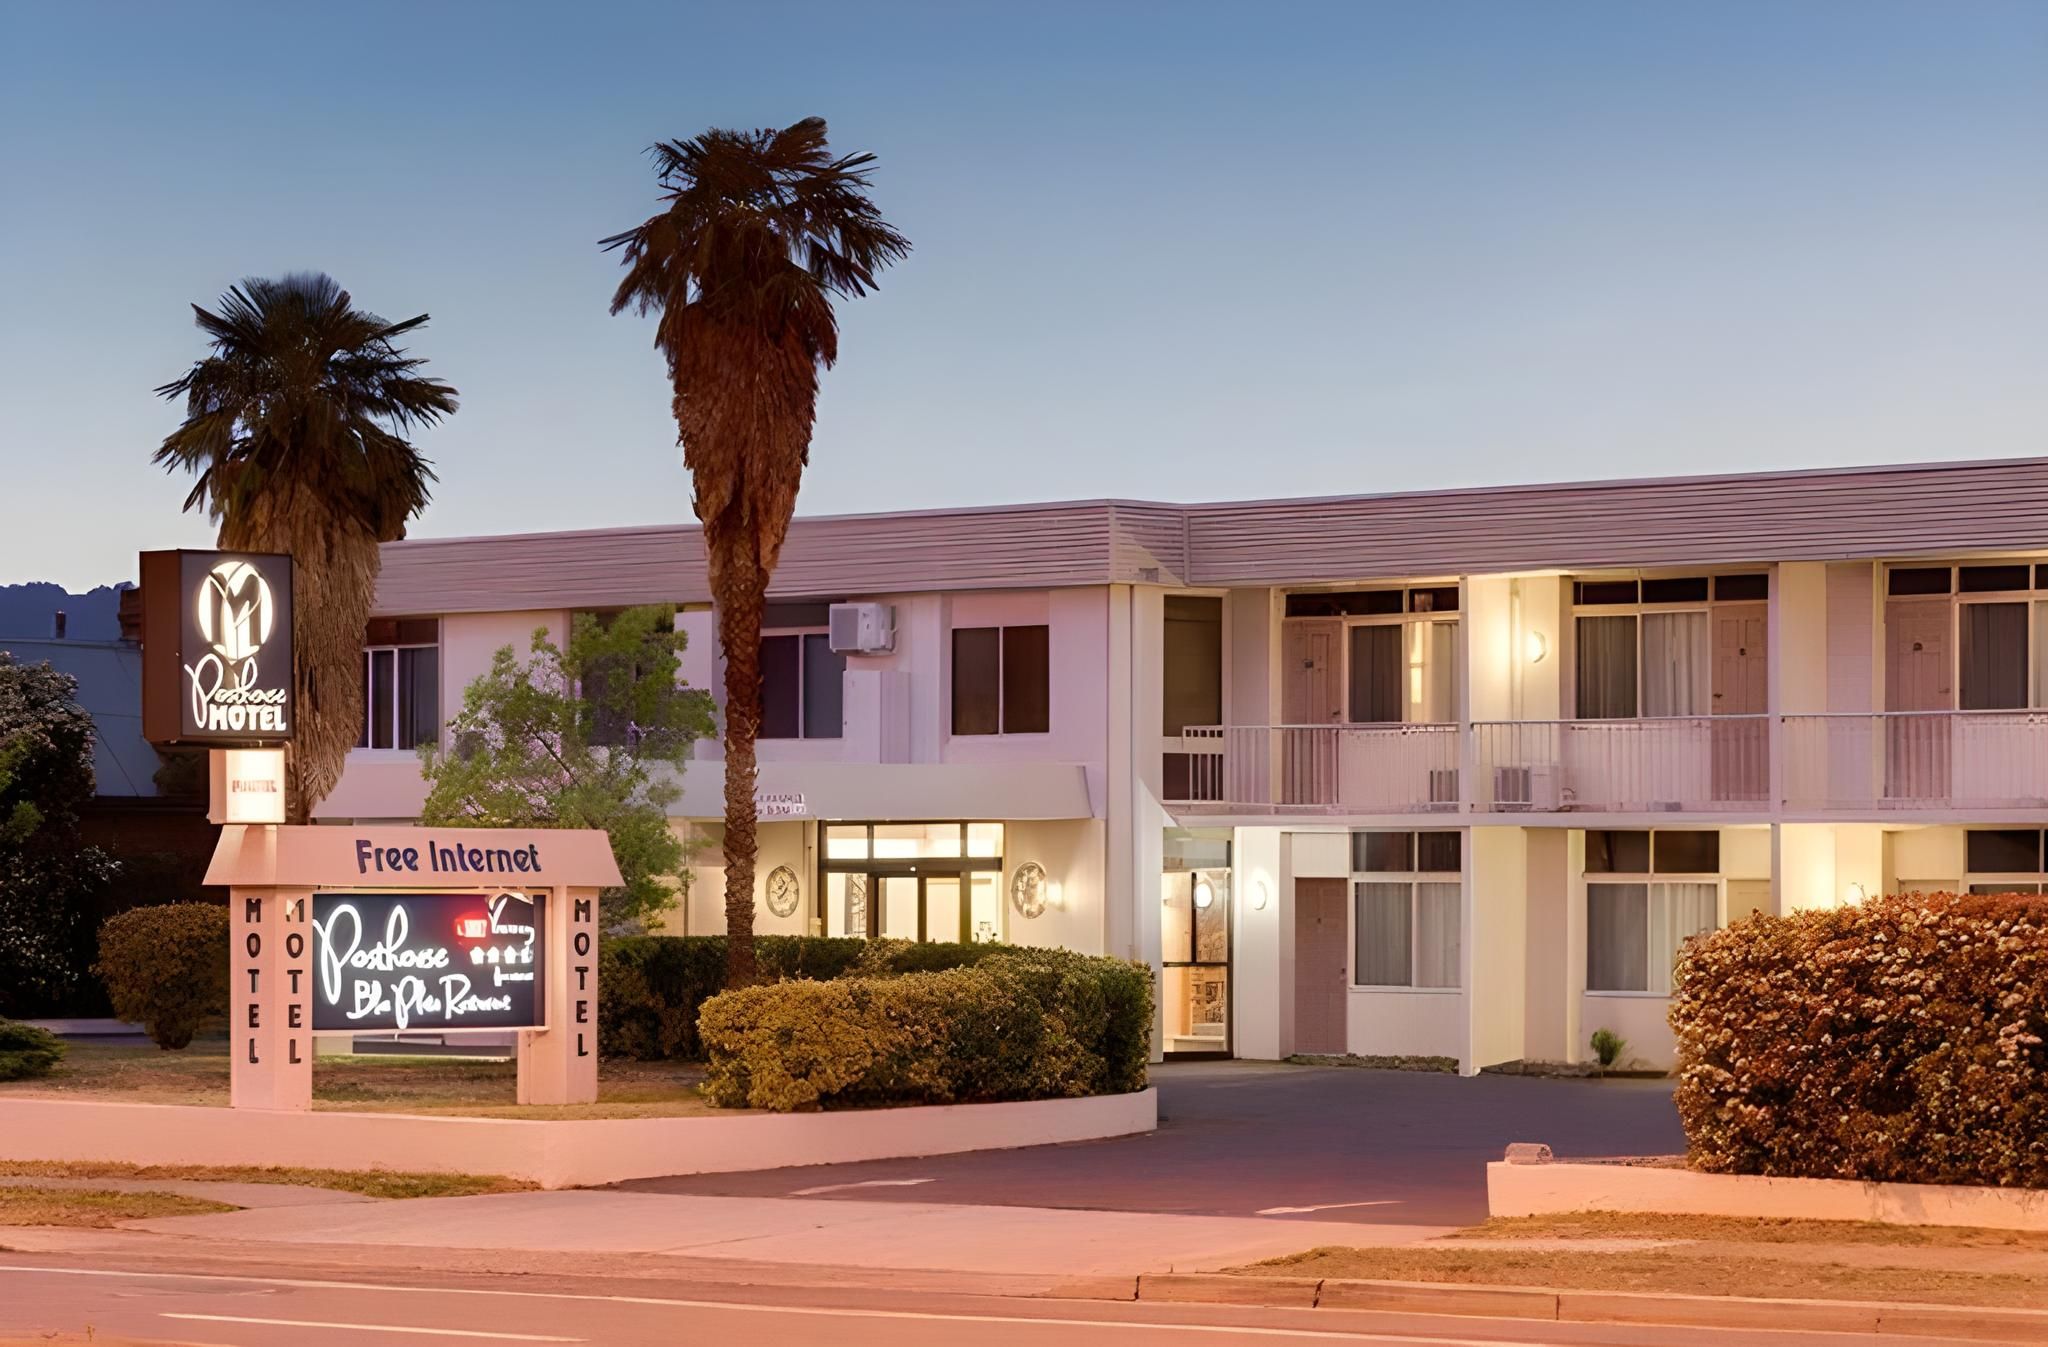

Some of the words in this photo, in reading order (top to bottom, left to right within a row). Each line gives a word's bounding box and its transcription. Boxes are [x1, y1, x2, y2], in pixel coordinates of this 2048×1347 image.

[355, 839, 419, 874] Free
[428, 840, 542, 873] Internet
[245, 898, 262, 1064] MOTEL
[285, 898, 305, 1064] MOTEL
[574, 898, 591, 1057] MOTEL
